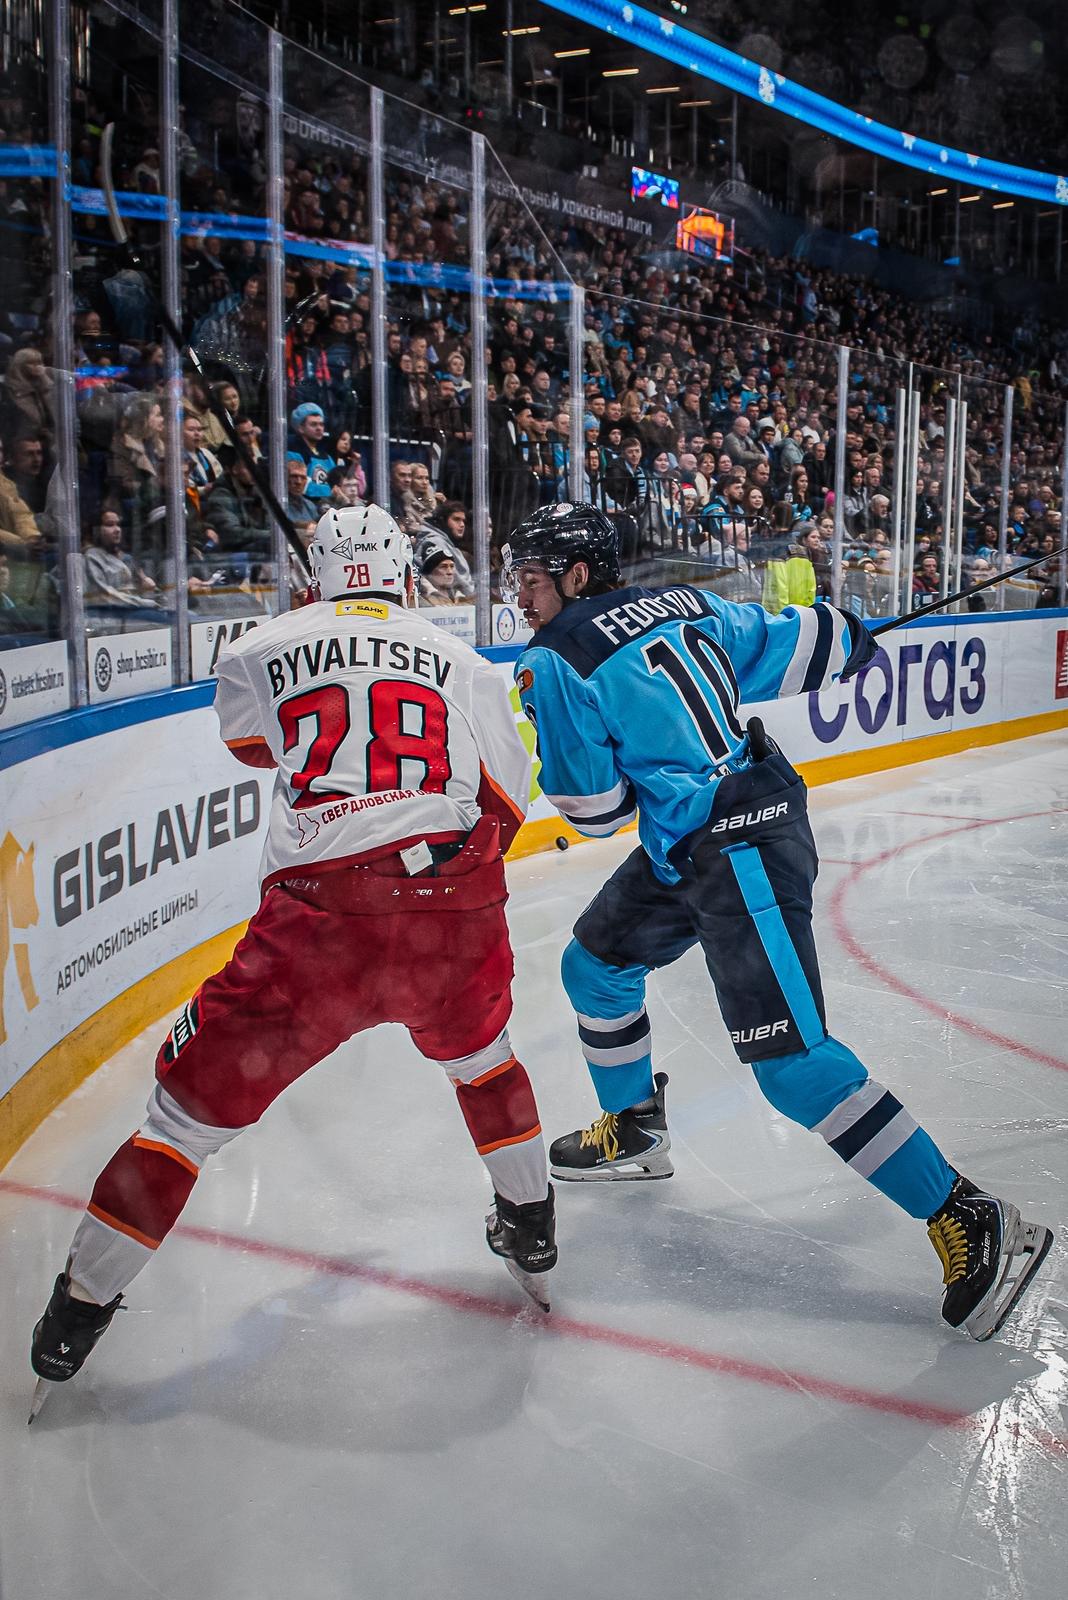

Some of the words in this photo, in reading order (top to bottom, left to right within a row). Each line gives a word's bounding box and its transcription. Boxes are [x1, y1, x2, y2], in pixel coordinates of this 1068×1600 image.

[625, 216, 653, 236] ЛИГИ
[354, 543, 378, 553] РМК
[343, 563, 371, 589] 28
[356, 605, 384, 615] БАНК
[266, 636, 452, 699] BYVALTSEV
[640, 623, 746, 766] 10
[277, 678, 453, 810] 28
[321, 789, 415, 825] СВЕРДЛОВСКАЯ
[711, 801, 789, 833] BAUER
[53, 779, 261, 928] GISLAVED
[56, 909, 159, 995] АВТОМОБИЛЬНЫЕ
[160, 889, 199, 926] ШИНЫ
[731, 1019, 789, 1044] AUER
